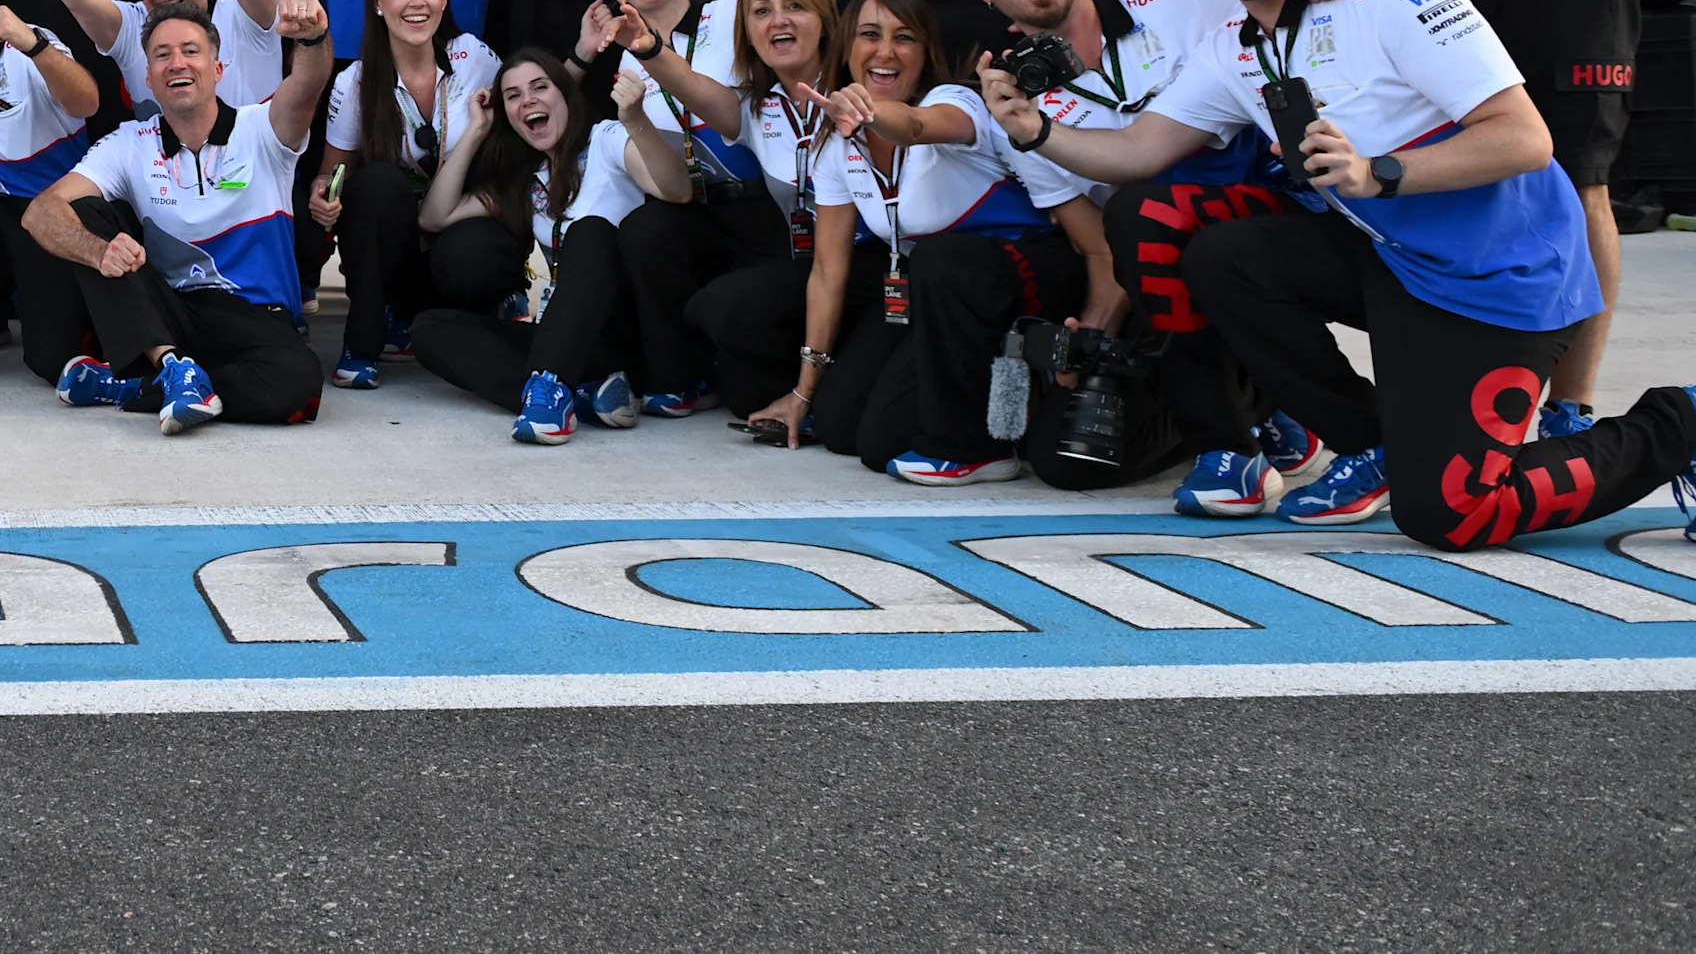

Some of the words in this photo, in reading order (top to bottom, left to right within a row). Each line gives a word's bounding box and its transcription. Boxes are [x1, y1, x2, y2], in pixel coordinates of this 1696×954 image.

[1311, 15, 1333, 26] VISA
[448, 51, 468, 61] UGO
[1572, 64, 1632, 87] HUGO
[150, 197, 177, 206] TUDOR
